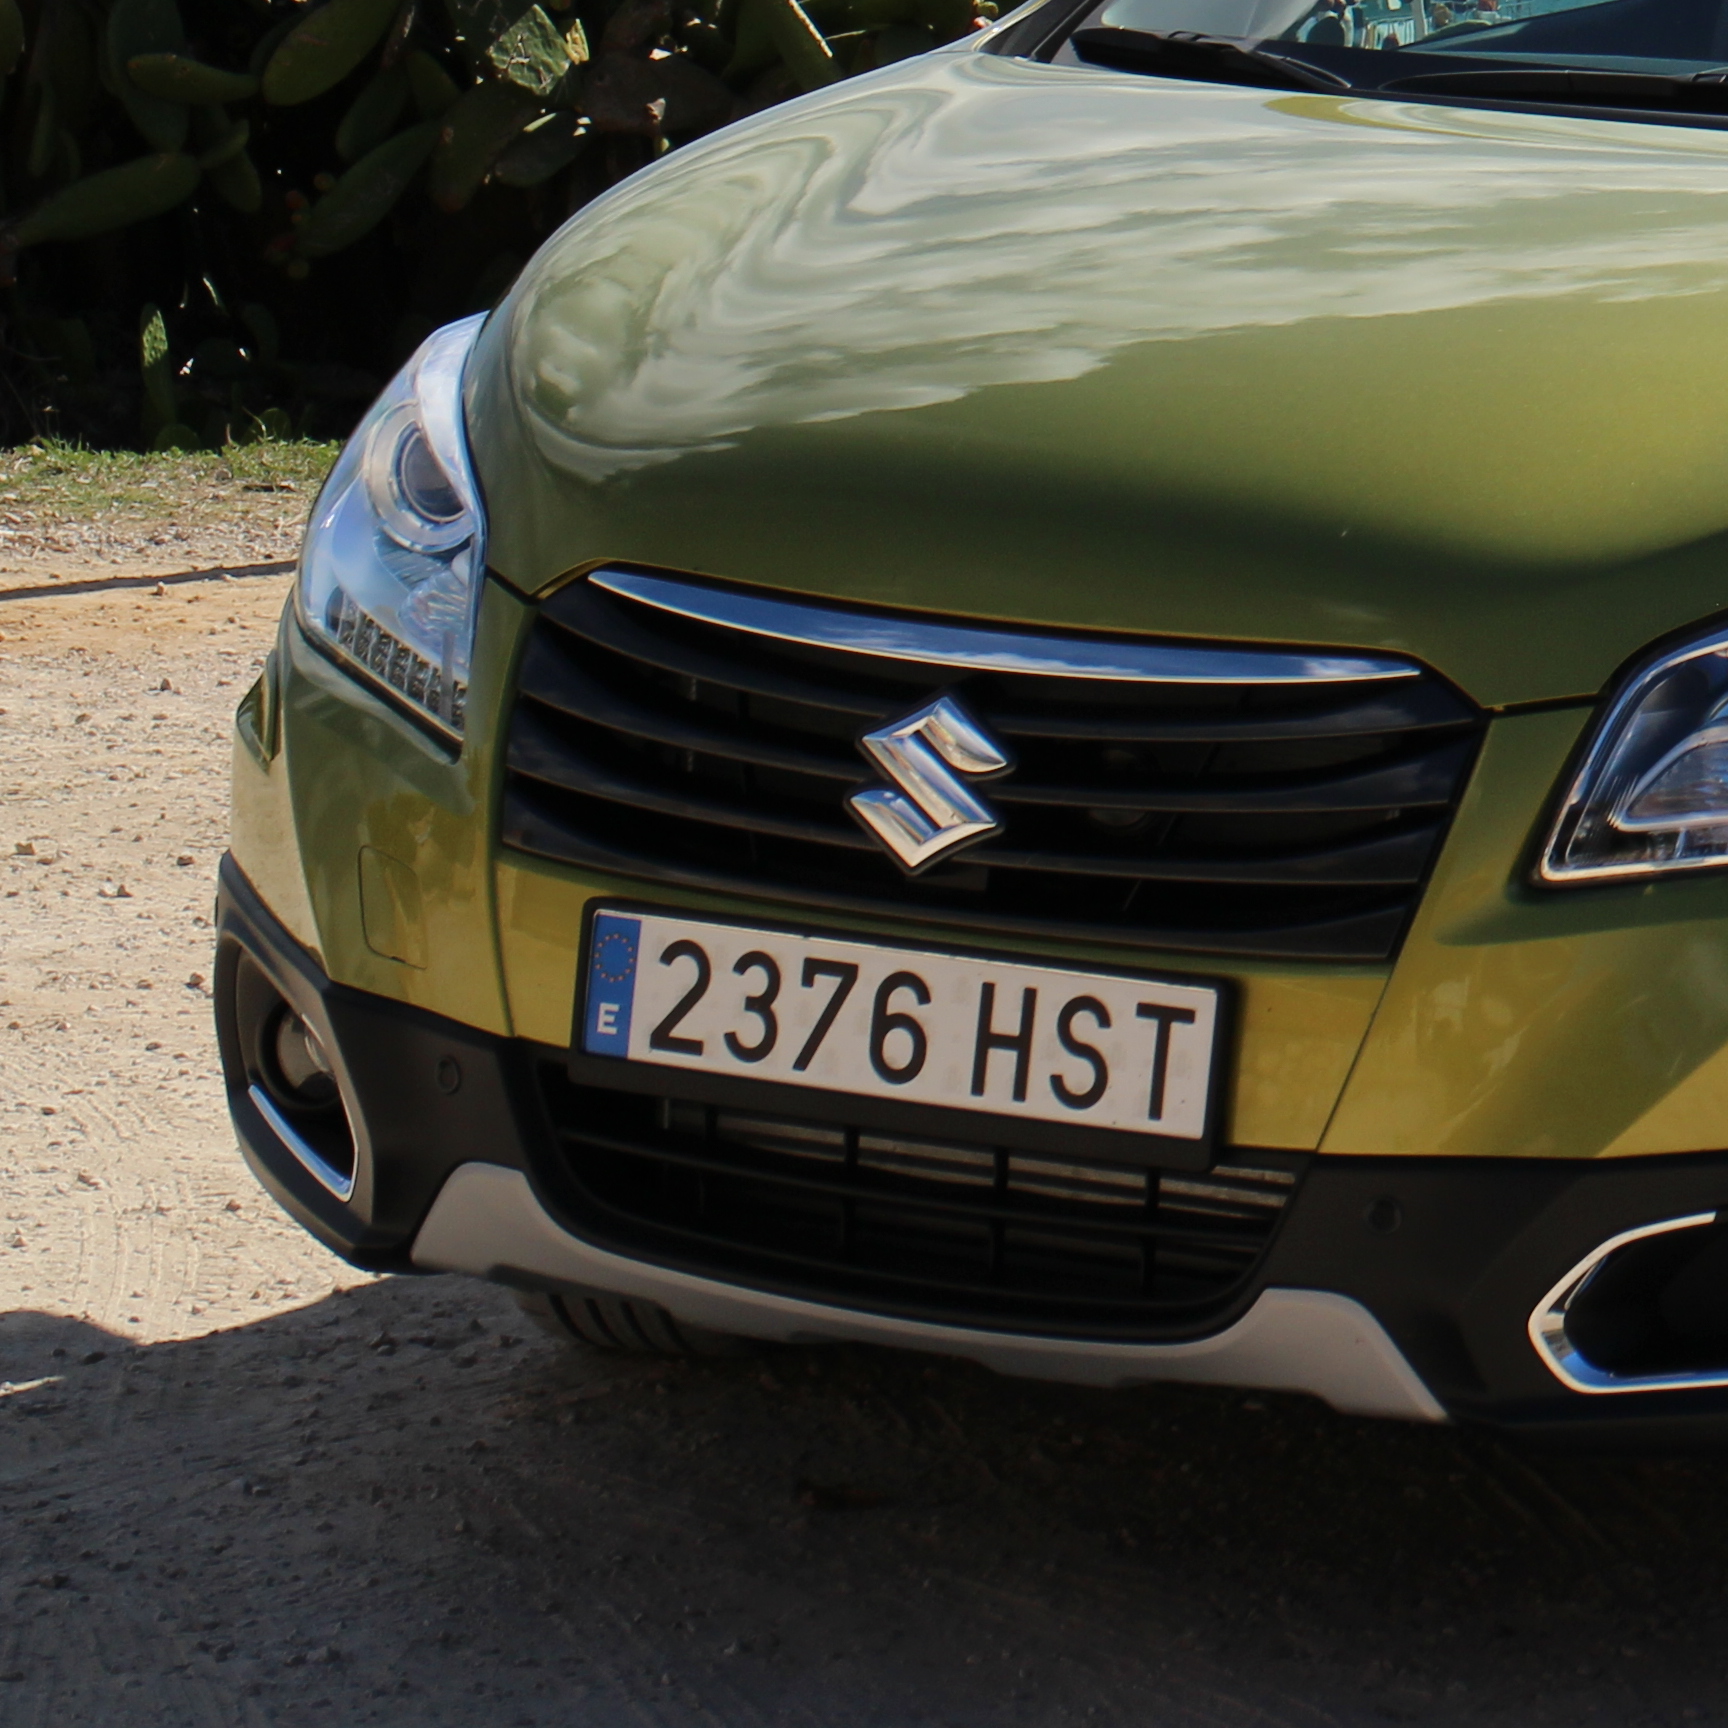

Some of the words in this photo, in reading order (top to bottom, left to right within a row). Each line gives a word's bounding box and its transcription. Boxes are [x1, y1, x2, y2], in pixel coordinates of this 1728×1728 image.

[597, 1002, 619, 1035] E
[649, 938, 932, 1085] 2376
[970, 981, 1197, 1122] HST
